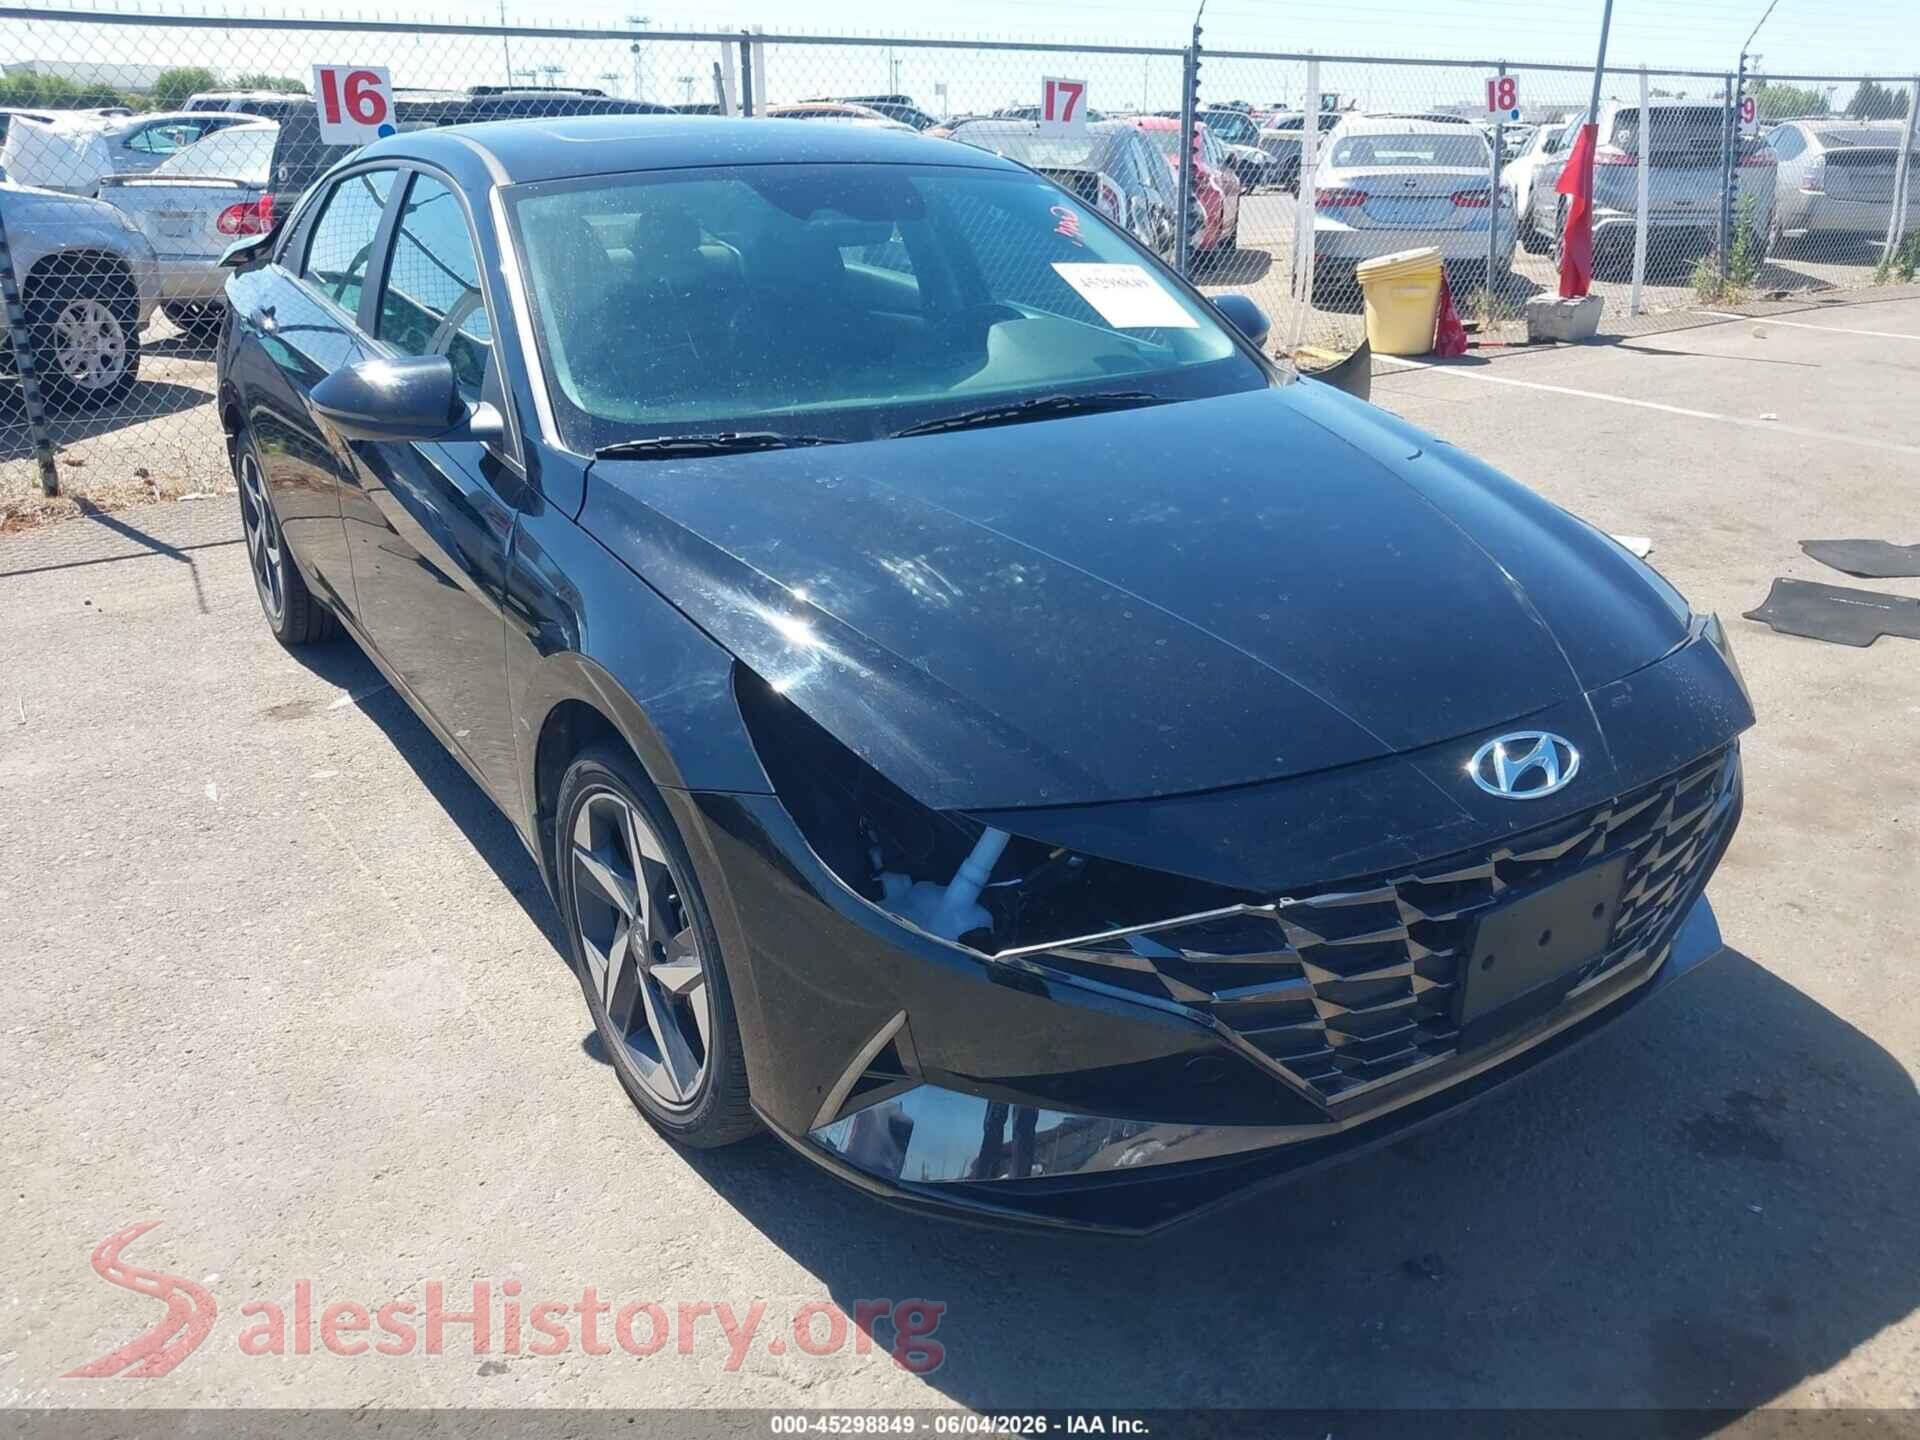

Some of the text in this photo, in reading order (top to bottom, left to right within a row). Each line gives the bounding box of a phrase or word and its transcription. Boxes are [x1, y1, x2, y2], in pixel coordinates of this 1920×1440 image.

[320, 70, 387, 125] 16
[1045, 80, 1083, 122] 17
[1488, 78, 1516, 112] 18
[1742, 97, 1755, 123] 9
